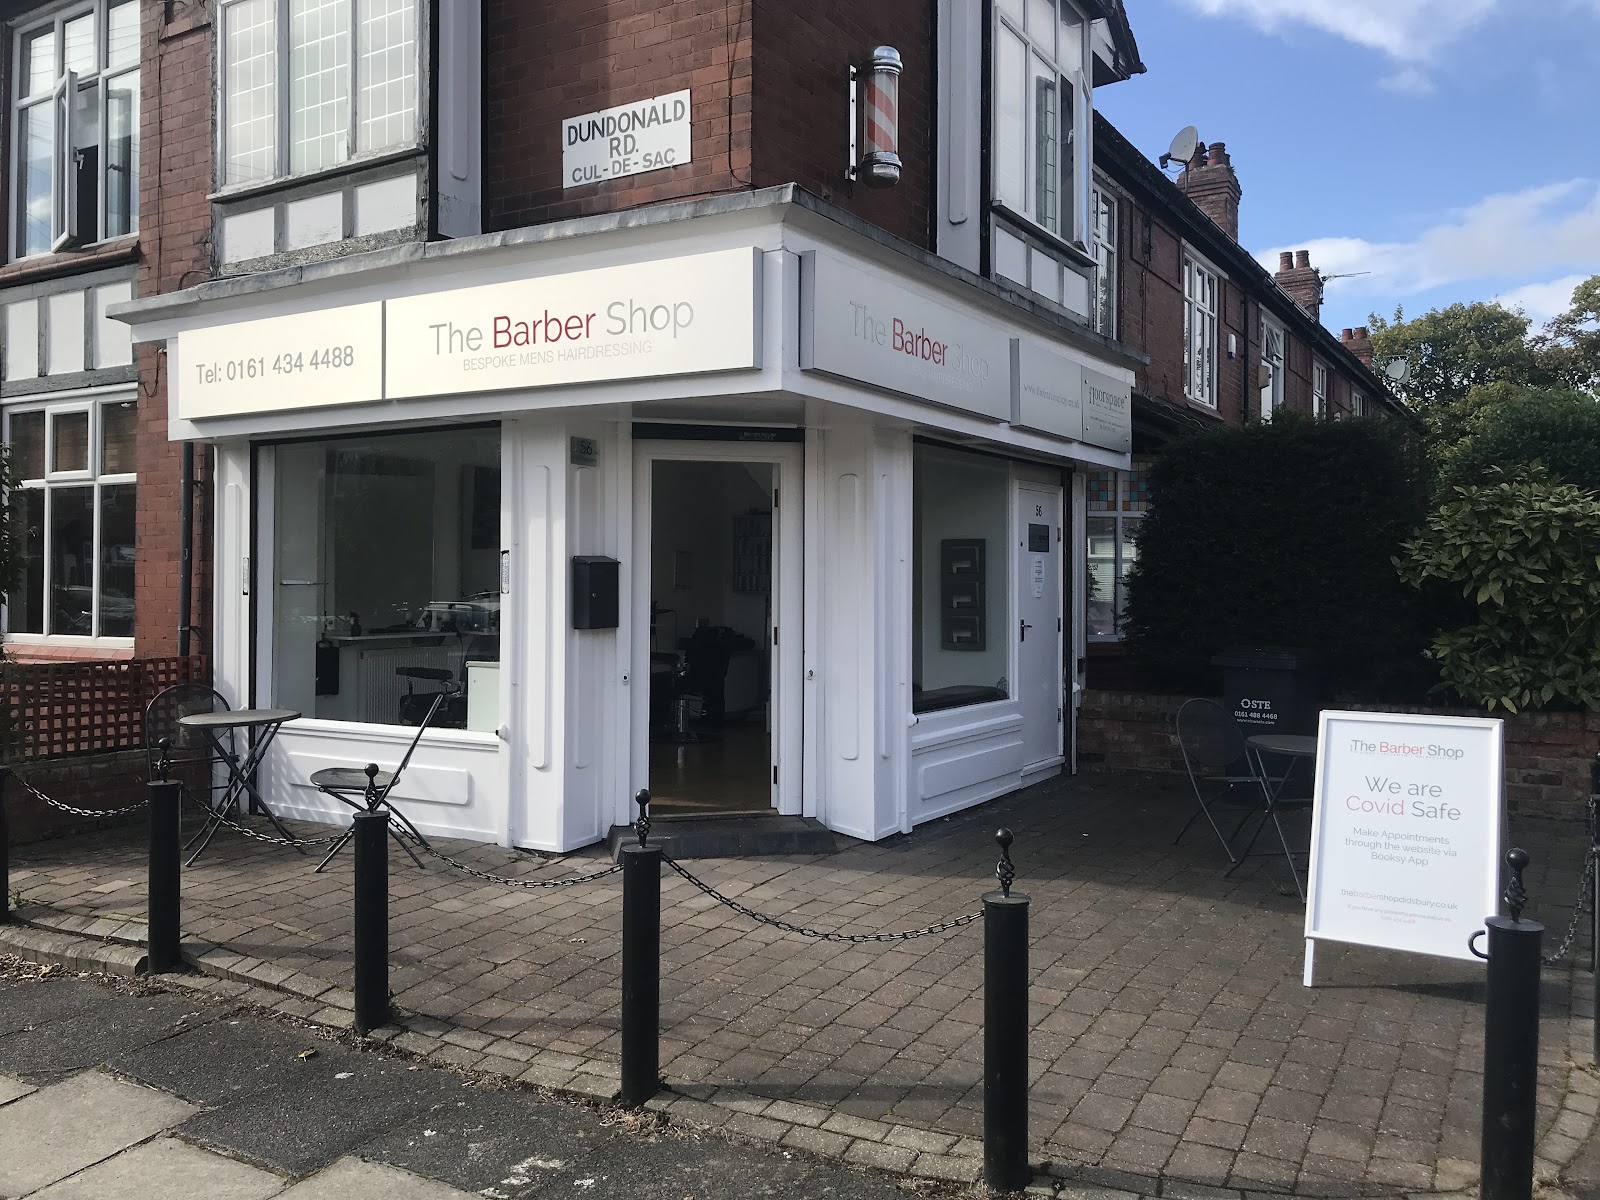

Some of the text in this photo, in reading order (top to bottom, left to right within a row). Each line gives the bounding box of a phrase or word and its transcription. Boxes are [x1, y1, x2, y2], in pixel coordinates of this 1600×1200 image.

[567, 99, 686, 146] DUNDONALD
[609, 133, 639, 159] RD.
[429, 298, 694, 355] The Barber Shop
[463, 339, 653, 372] BESPOKE MENS HAIRDRESSING
[849, 300, 989, 388] The Barber Shop
[195, 345, 354, 385] Tel: 0161 434 4488
[1088, 385, 1125, 411] floorspace
[579, 440, 593, 456] 56
[1035, 504, 1043, 517] 56
[1234, 710, 1249, 718] 0161
[1351, 739, 1377, 753] The
[1379, 741, 1425, 755] Barber
[1427, 744, 1464, 761] Shop
[1365, 775, 1443, 798] We are
[1346, 795, 1461, 821] Covid Safe
[1345, 838, 1457, 857] through the website via
[1353, 827, 1450, 845] Make Appointments
[1371, 852, 1429, 867] Booksy App
[1341, 888, 1458, 910] thebarbershopdidsbury.co.uk
